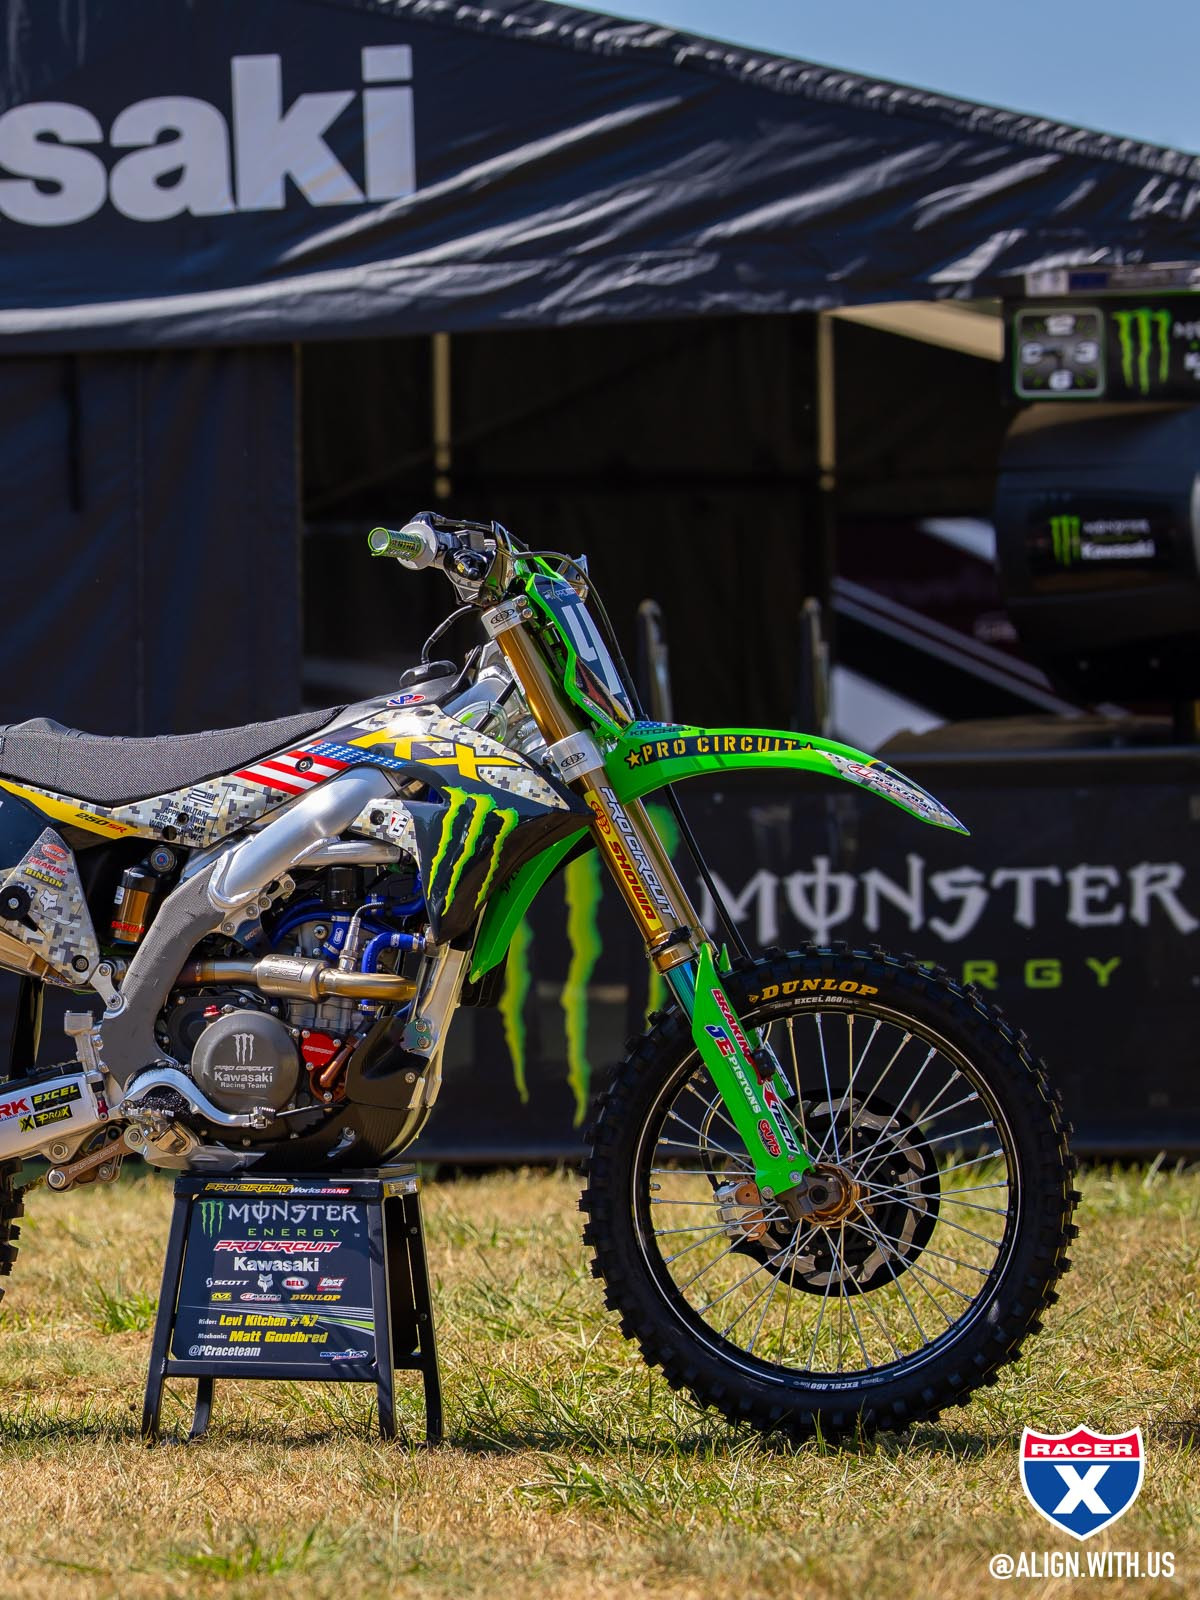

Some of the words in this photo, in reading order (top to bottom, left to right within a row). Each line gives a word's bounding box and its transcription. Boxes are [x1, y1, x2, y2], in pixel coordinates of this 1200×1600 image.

[642, 739, 686, 763] PRO
[697, 736, 797, 754] CIRCUIT
[182, 804, 210, 818] MILITARY
[600, 786, 634, 834] PRO
[625, 834, 679, 920] CIRCUIT
[608, 840, 657, 920] SHOWA
[697, 853, 1198, 945] MONSTER
[761, 978, 879, 1001] DUNLOP
[794, 996, 824, 1005] EXCEL
[711, 988, 756, 1067] BRAKIN
[704, 1024, 736, 1058] JE
[728, 1056, 762, 1115] PISTONS
[214, 1072, 273, 1083] Kawasaki
[33, 1085, 79, 1105] EXCEL
[205, 1183, 237, 1192] PRO
[237, 1183, 294, 1193] CIRCUIT
[228, 1200, 360, 1224] MONSTER
[248, 1228, 339, 1237] ENERGY
[214, 1240, 260, 1253] PRO
[260, 1240, 342, 1254] CIRCUIT
[234, 1256, 319, 1272] Kawasaki
[290, 1293, 342, 1301] DUNLOP
[219, 1314, 243, 1326] Levi
[245, 1314, 287, 1327] Kitchen
[229, 1330, 261, 1342] Matt
[264, 1331, 328, 1343] Goodbred
[188, 1345, 261, 1357] @PCraceteam
[829, 1381, 859, 1390] EXCEL
